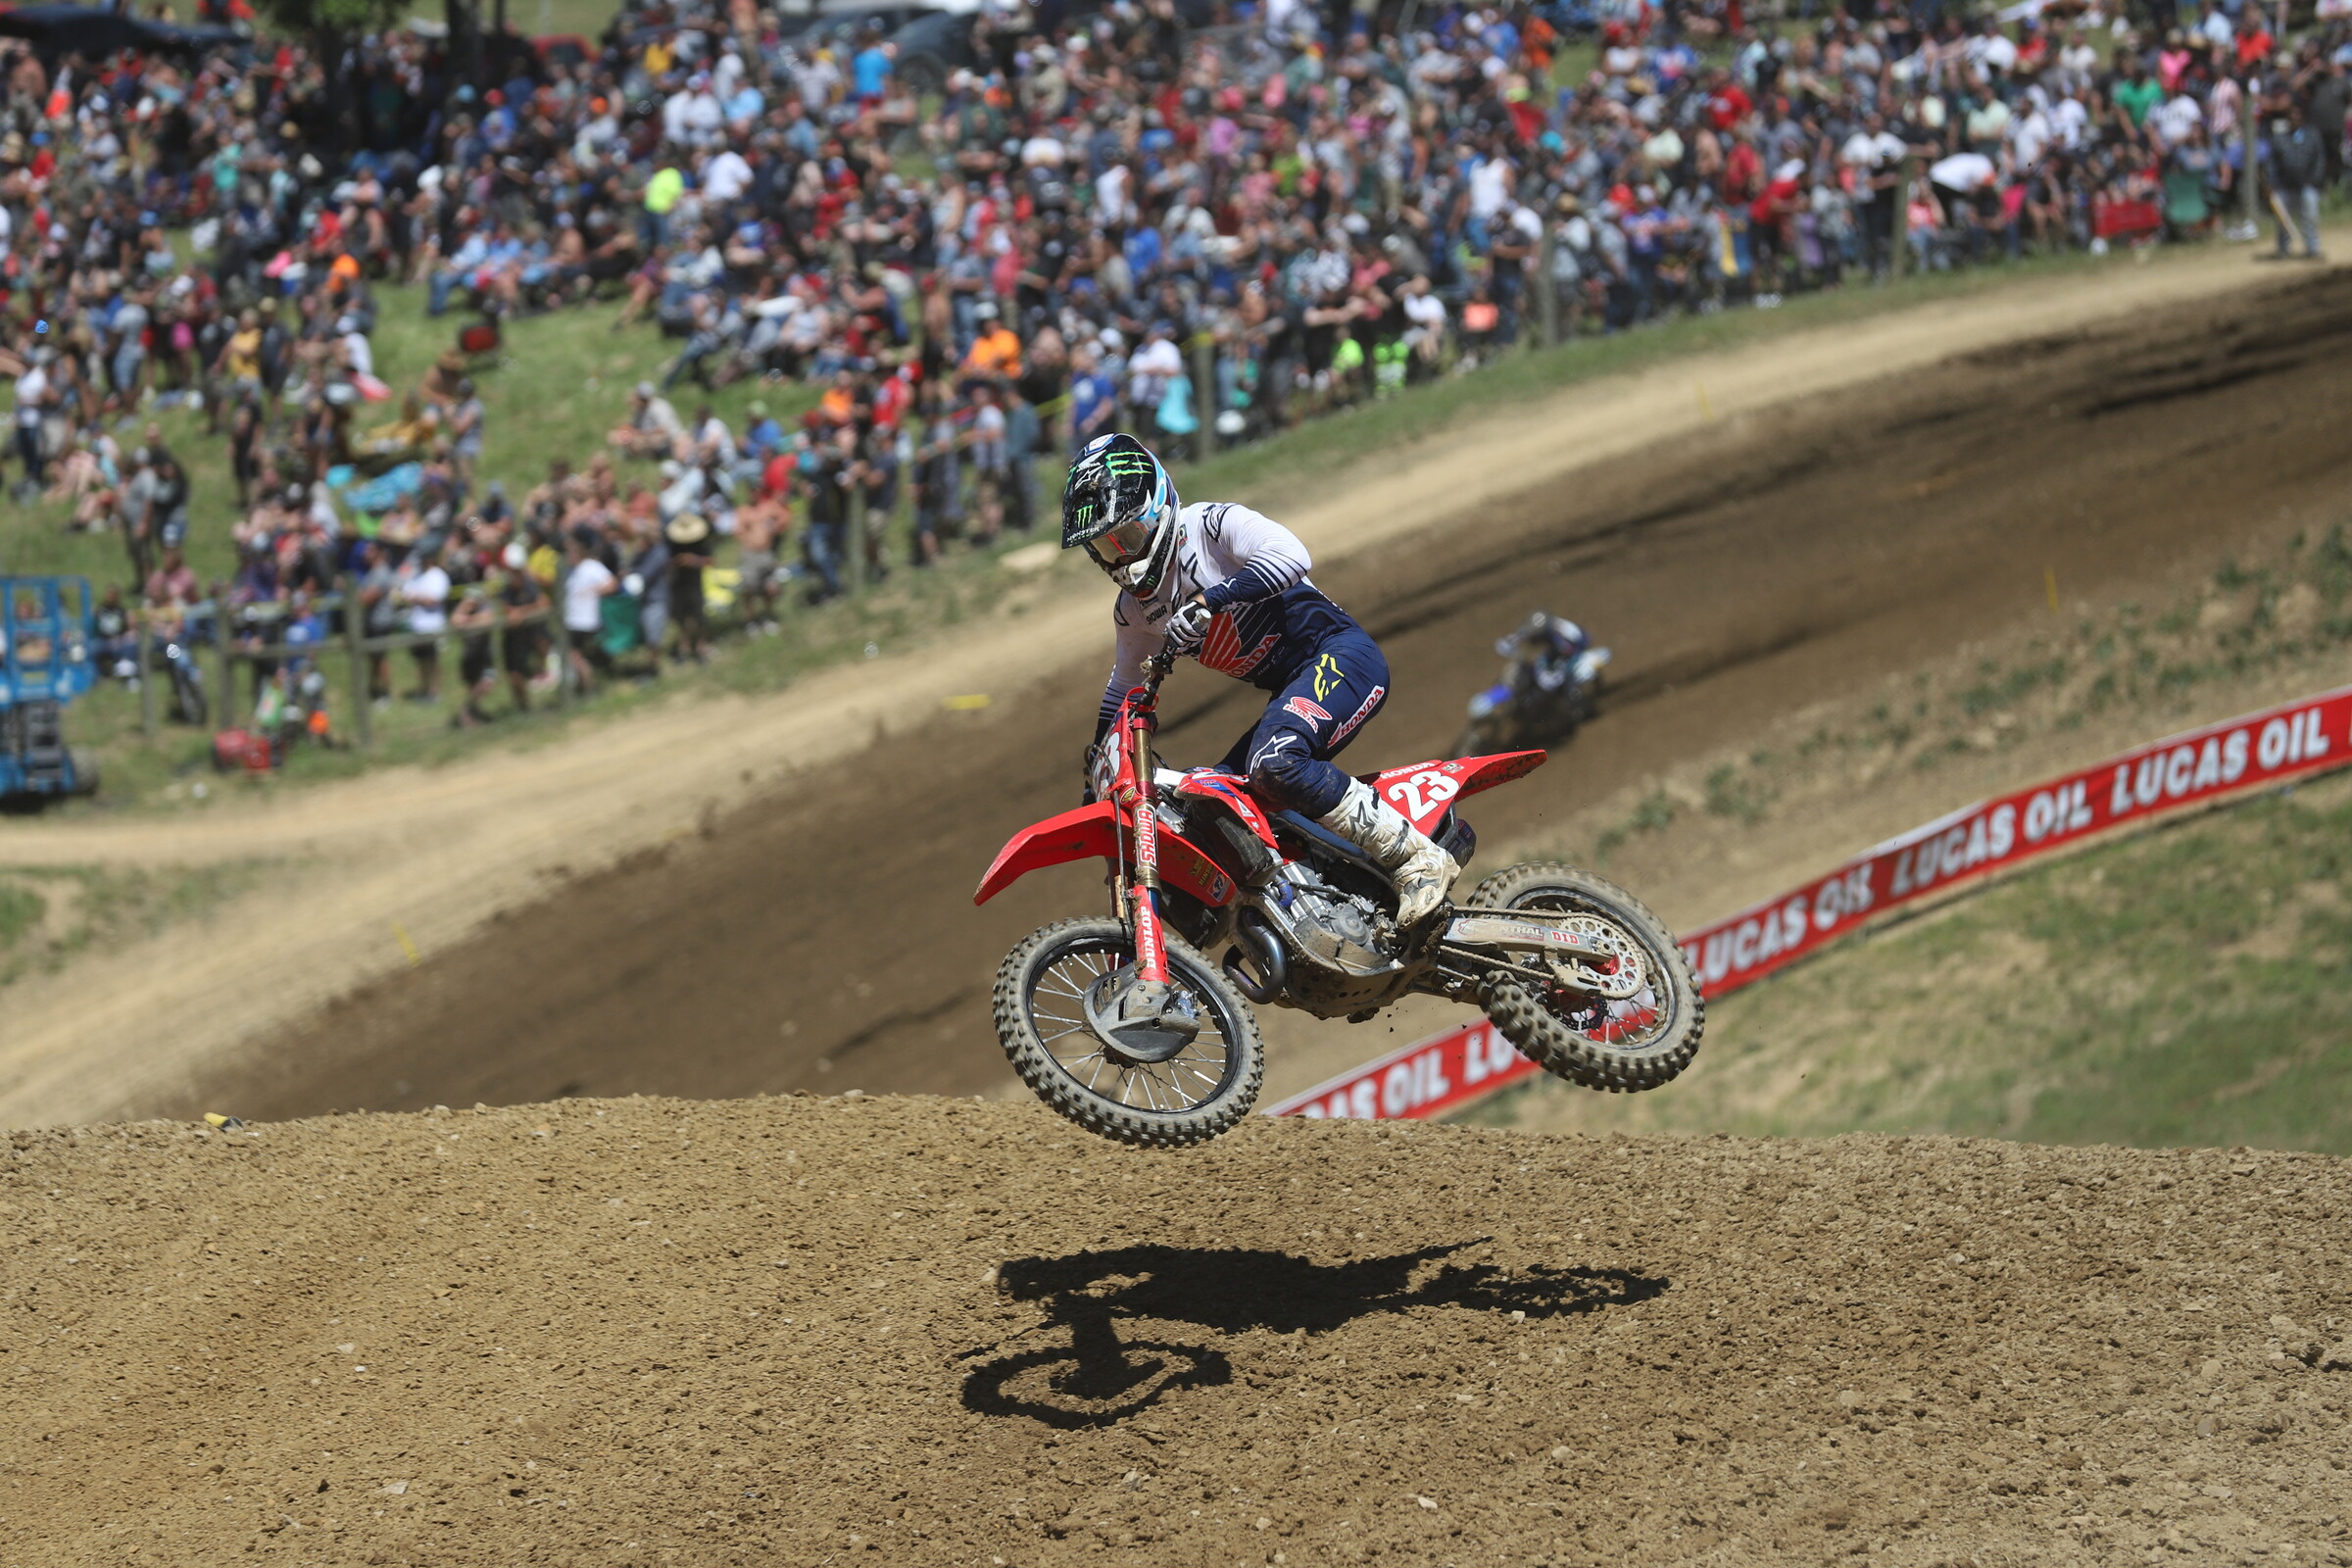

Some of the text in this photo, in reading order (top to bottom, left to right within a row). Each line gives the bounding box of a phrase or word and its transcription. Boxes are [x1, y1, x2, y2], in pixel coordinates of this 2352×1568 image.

[1066, 526, 1100, 542] MONSTER
[1229, 634, 1281, 677] ONDA
[1285, 705, 1318, 731] HONDA
[1341, 688, 1384, 735] HONDA
[1380, 762, 1436, 779] HONDA
[1387, 770, 1460, 822] 23
[1891, 804, 2016, 897] LUCAS
[2024, 780, 2092, 842] OIL
[2110, 728, 2249, 816] LUCAS
[2258, 707, 2329, 769] OIL
[1139, 808, 1157, 865] SHOWA
[1141, 906, 1156, 969] DUNLOP
[1551, 931, 1579, 944] DID
[1381, 1048, 1450, 1117] OIL
